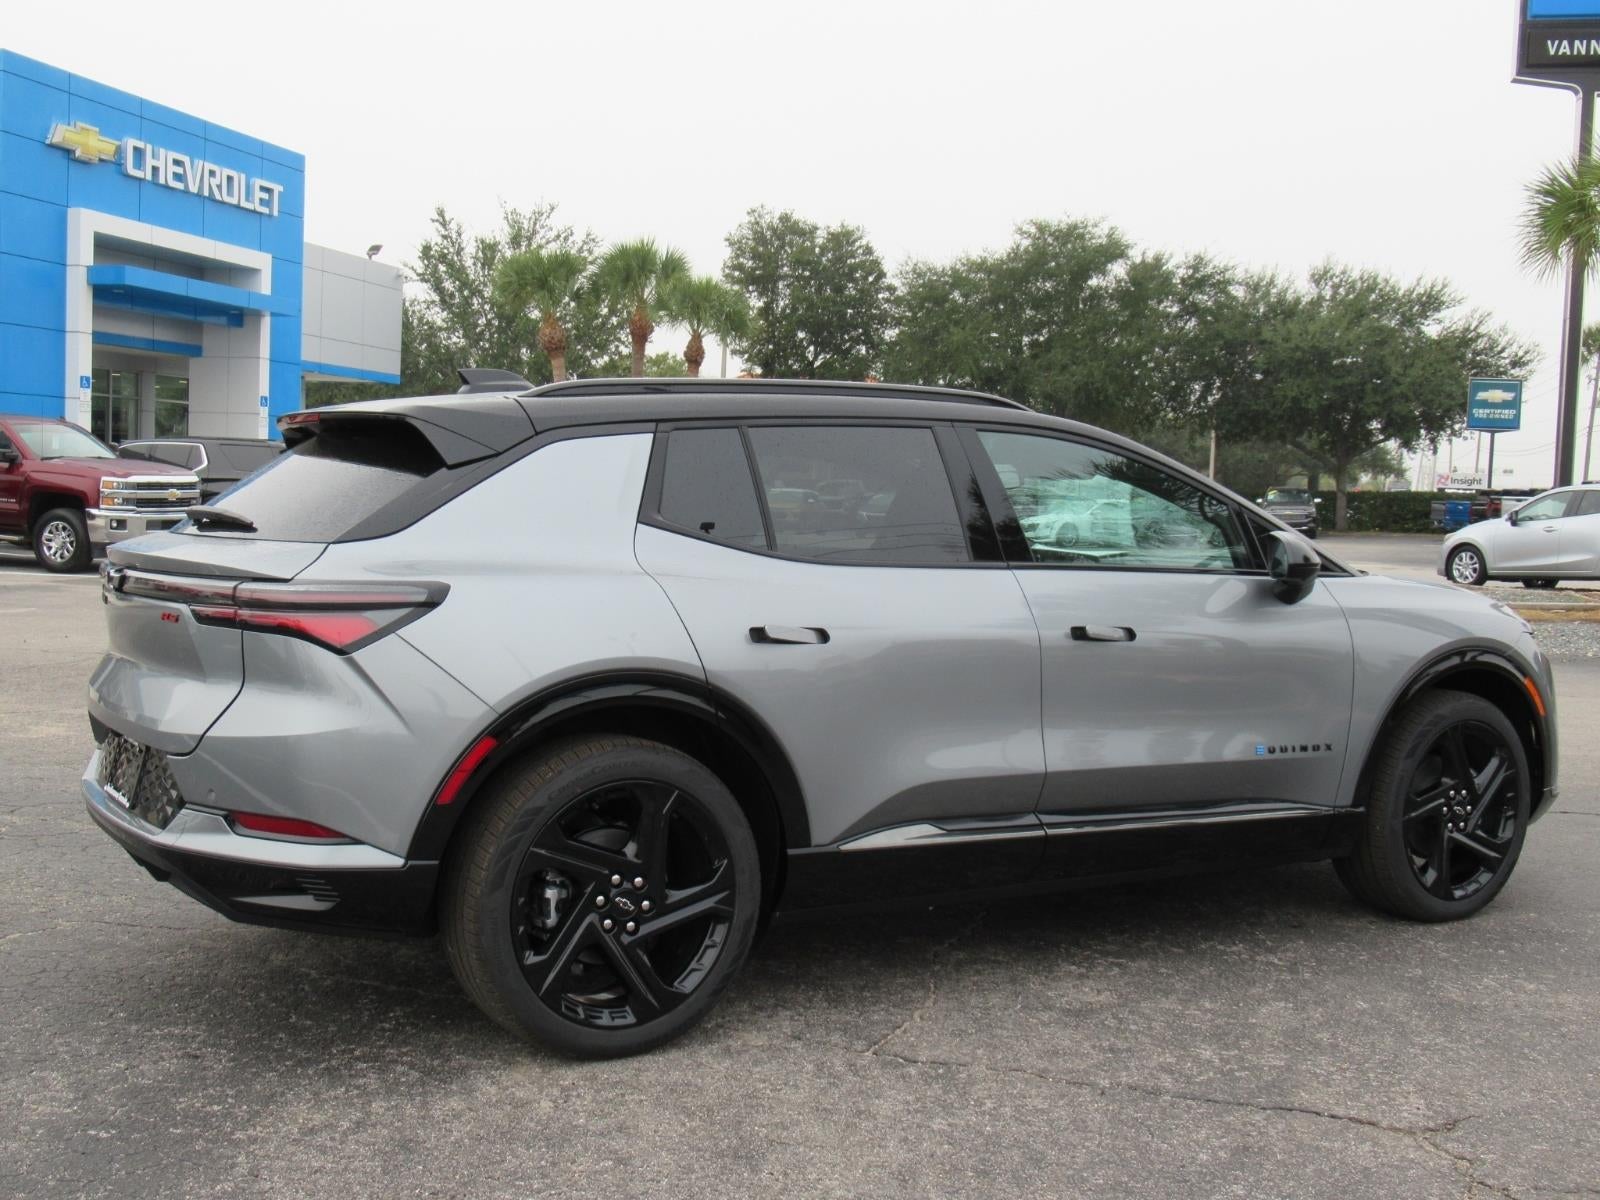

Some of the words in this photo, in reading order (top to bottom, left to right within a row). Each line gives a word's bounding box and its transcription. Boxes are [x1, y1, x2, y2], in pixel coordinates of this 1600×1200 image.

[1547, 39, 1600, 56] VANN
[121, 138, 283, 217] CHEVROLET
[1450, 475, 1483, 486] Insight
[1255, 743, 1333, 756] EQUINOX
